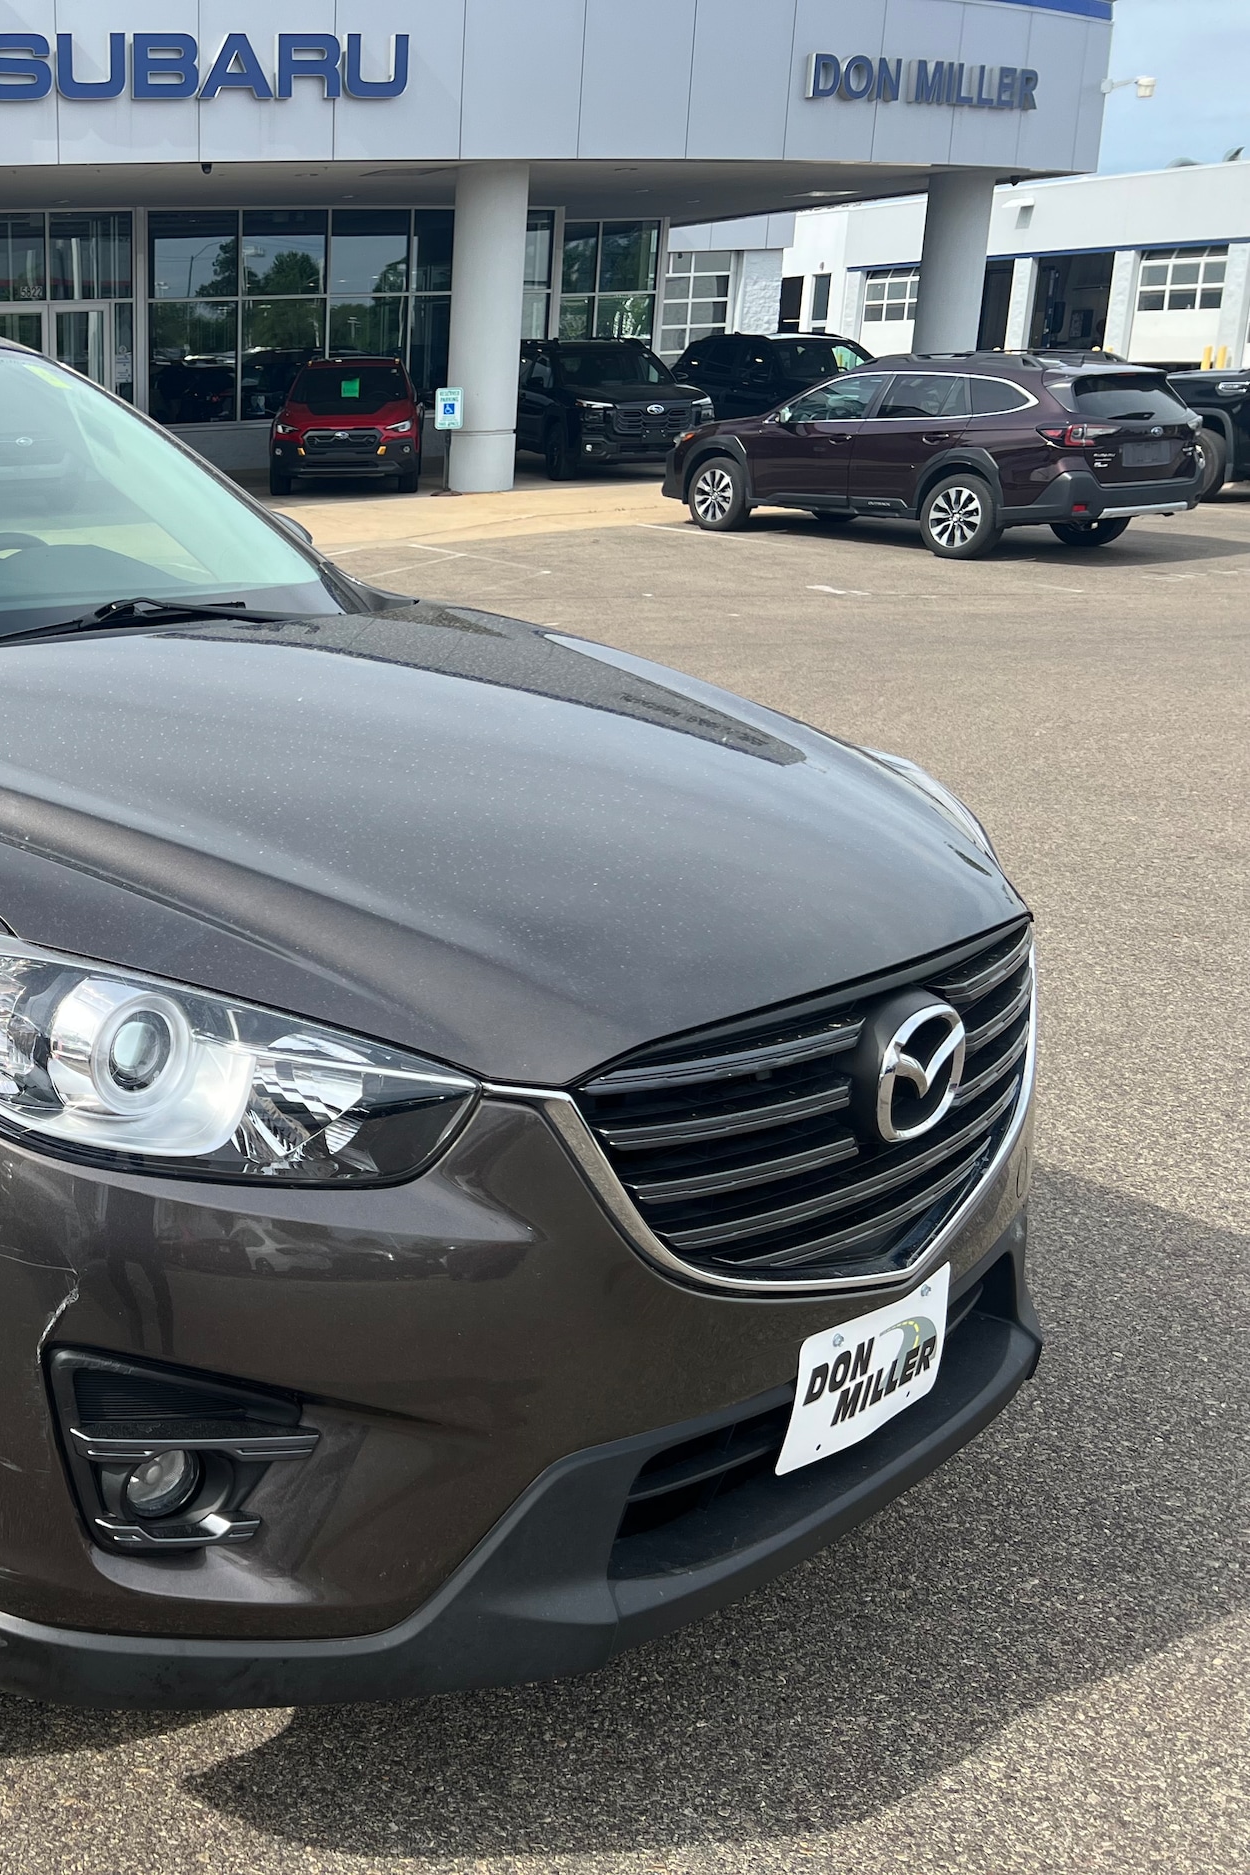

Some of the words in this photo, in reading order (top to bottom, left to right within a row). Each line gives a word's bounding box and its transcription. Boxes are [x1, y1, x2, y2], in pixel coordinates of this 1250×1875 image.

[806, 53, 902, 100] DON
[910, 59, 1039, 110] MILLER
[802, 1337, 875, 1407] DON
[830, 1335, 936, 1427] MILLER
